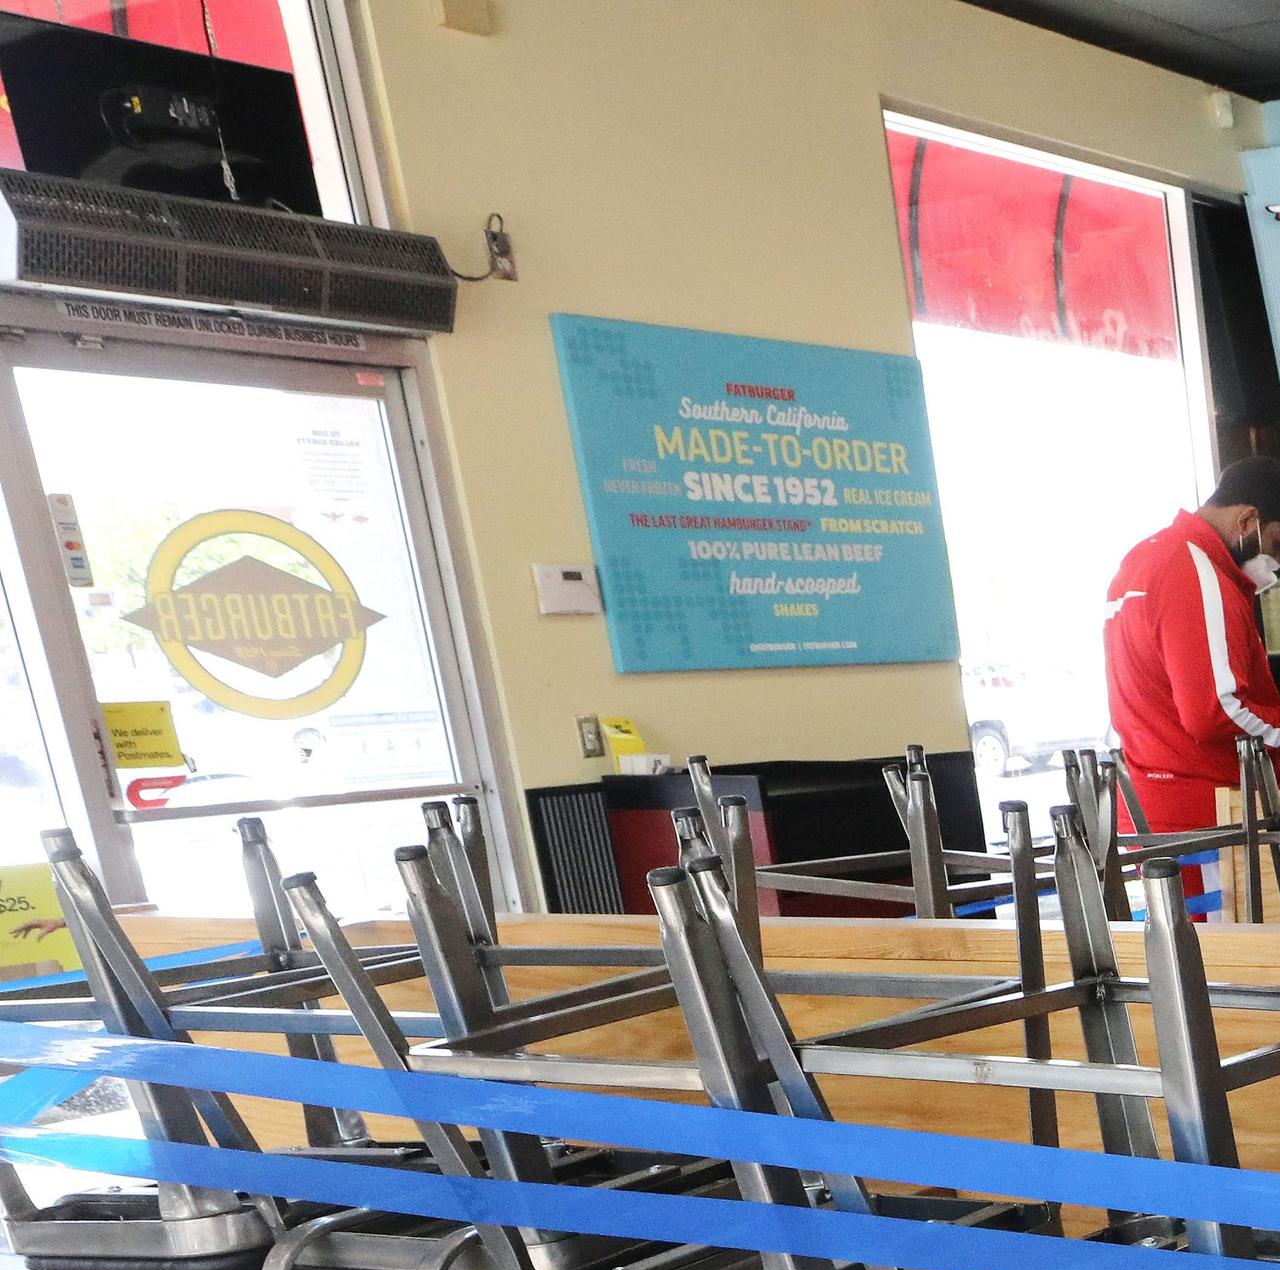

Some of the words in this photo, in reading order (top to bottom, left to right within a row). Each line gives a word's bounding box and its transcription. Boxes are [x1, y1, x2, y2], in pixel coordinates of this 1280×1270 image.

[64, 302, 89, 318] THIS
[91, 304, 120, 321] DOOR
[123, 309, 151, 326] MUST
[155, 312, 194, 329] REMAIN
[725, 382, 795, 400] FATBURGER
[679, 395, 763, 424] Southern
[766, 404, 848, 436] California
[654, 424, 910, 474] MADE-TO-ORDER
[683, 471, 772, 503] SINCE
[773, 477, 838, 506] 1952
[843, 487, 872, 505] REAL
[629, 513, 650, 528] THE
[652, 514, 677, 529] LAST
[680, 515, 711, 529] GREAT
[714, 517, 773, 531] HAMBURGER
[820, 517, 862, 533] FROM
[863, 519, 923, 535] SCRATCH
[688, 540, 740, 561] 100%
[742, 541, 791, 561] PURE
[793, 543, 841, 562] LEAN
[843, 544, 883, 562] BEEF
[728, 570, 861, 600] hand-scooped
[773, 603, 818, 617] SHAKES
[112, 729, 128, 737] We
[131, 727, 163, 736] deliver
[115, 741, 137, 749] with
